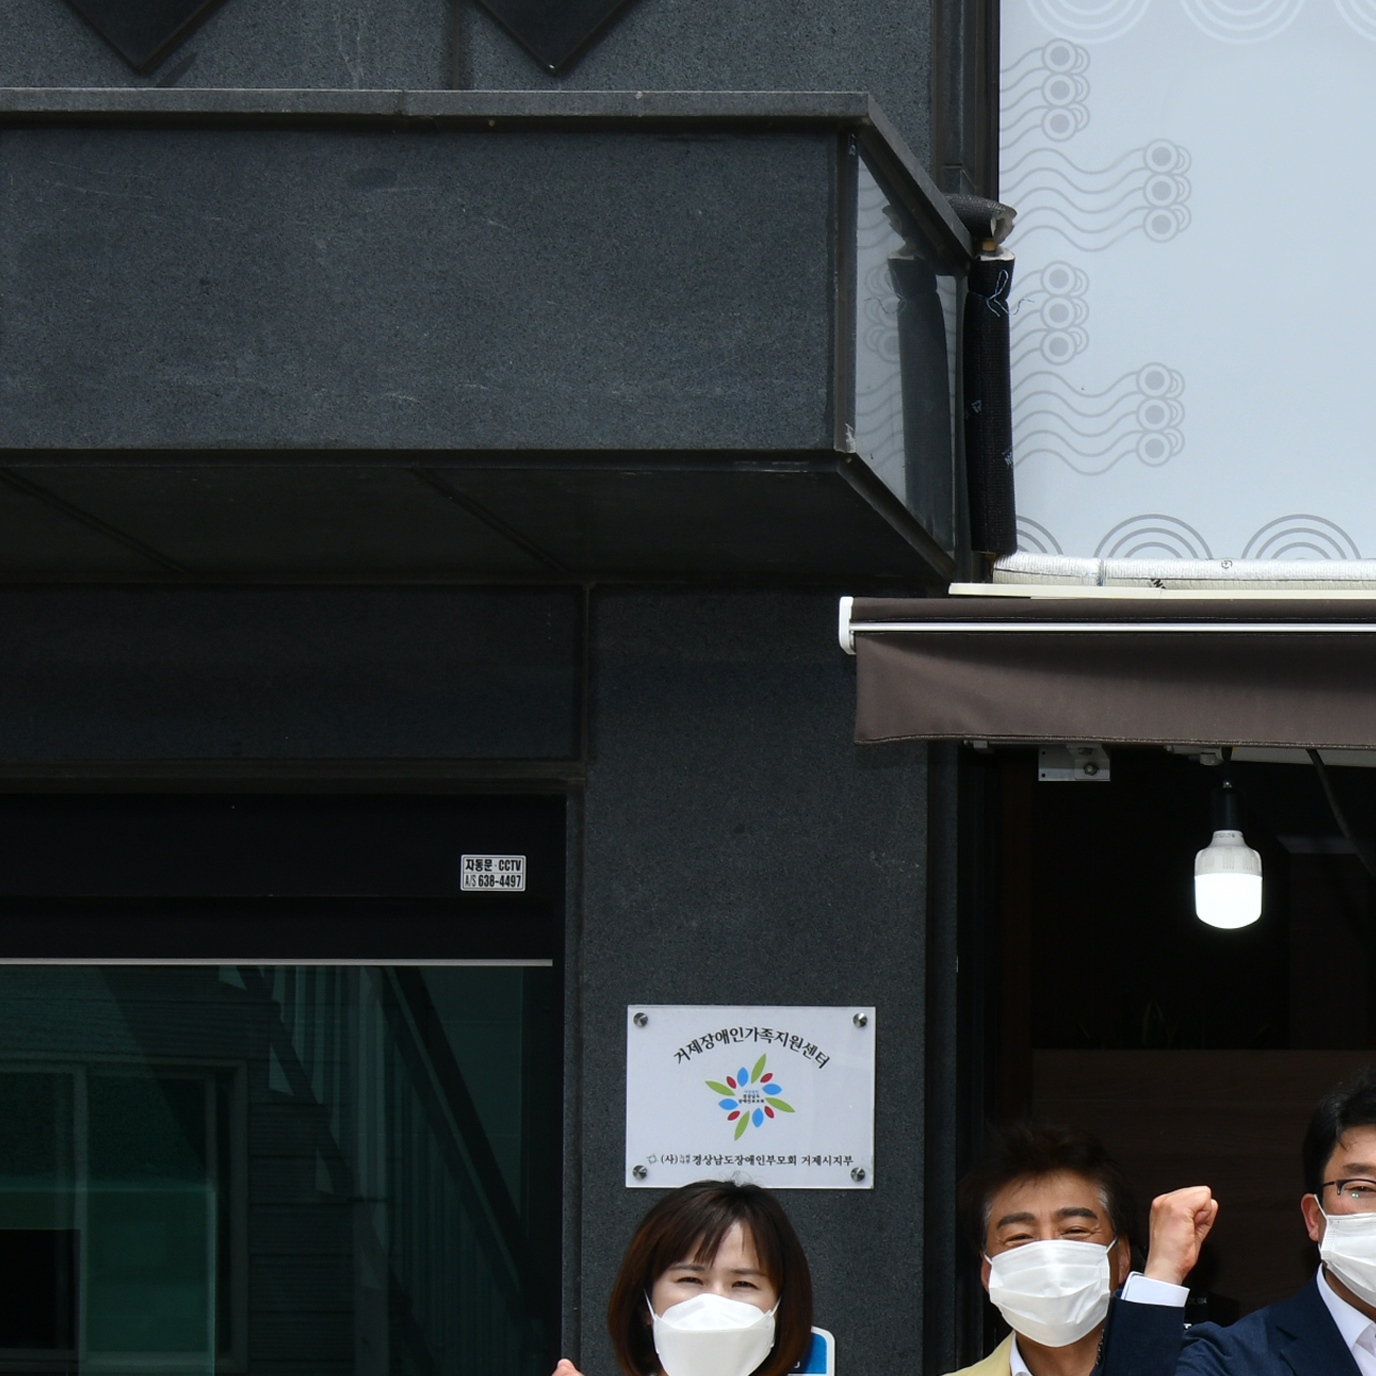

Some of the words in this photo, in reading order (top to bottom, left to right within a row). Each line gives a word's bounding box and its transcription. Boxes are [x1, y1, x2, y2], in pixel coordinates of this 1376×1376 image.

[465, 859, 493, 872] 자동문
[498, 859, 522, 872] CCTV
[478, 874, 522, 888] 638-4497
[673, 1026, 831, 1070] 거제장애인가족지원센터
[801, 1153, 855, 1167] 거제시지부
